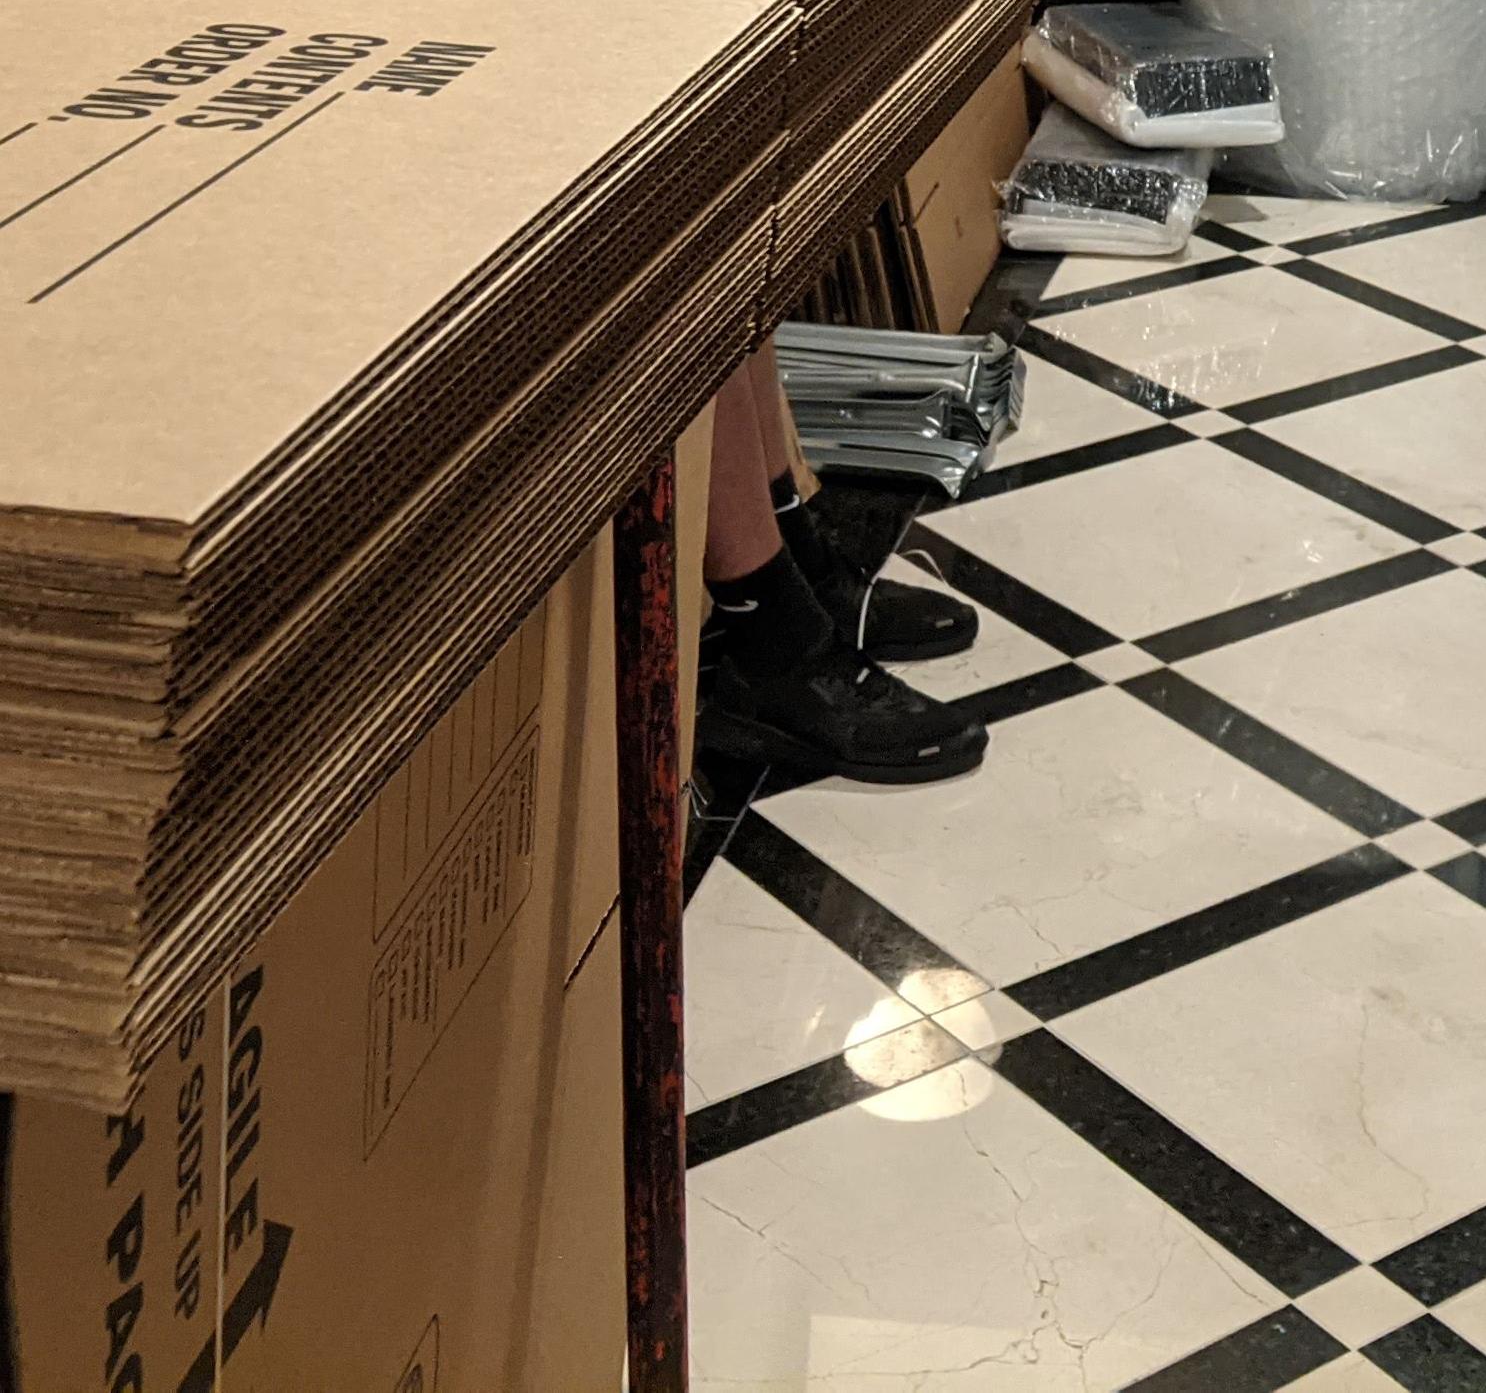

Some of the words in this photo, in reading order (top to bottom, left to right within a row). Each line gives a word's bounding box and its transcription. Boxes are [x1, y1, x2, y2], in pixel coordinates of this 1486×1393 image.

[117, 23, 288, 87] ORDER
[174, 32, 389, 132] CONTENTS
[353, 41, 497, 97] NAME
[45, 87, 181, 122] NO.
[177, 1064, 205, 1238] SIDE
[173, 1228, 202, 1321] UP
